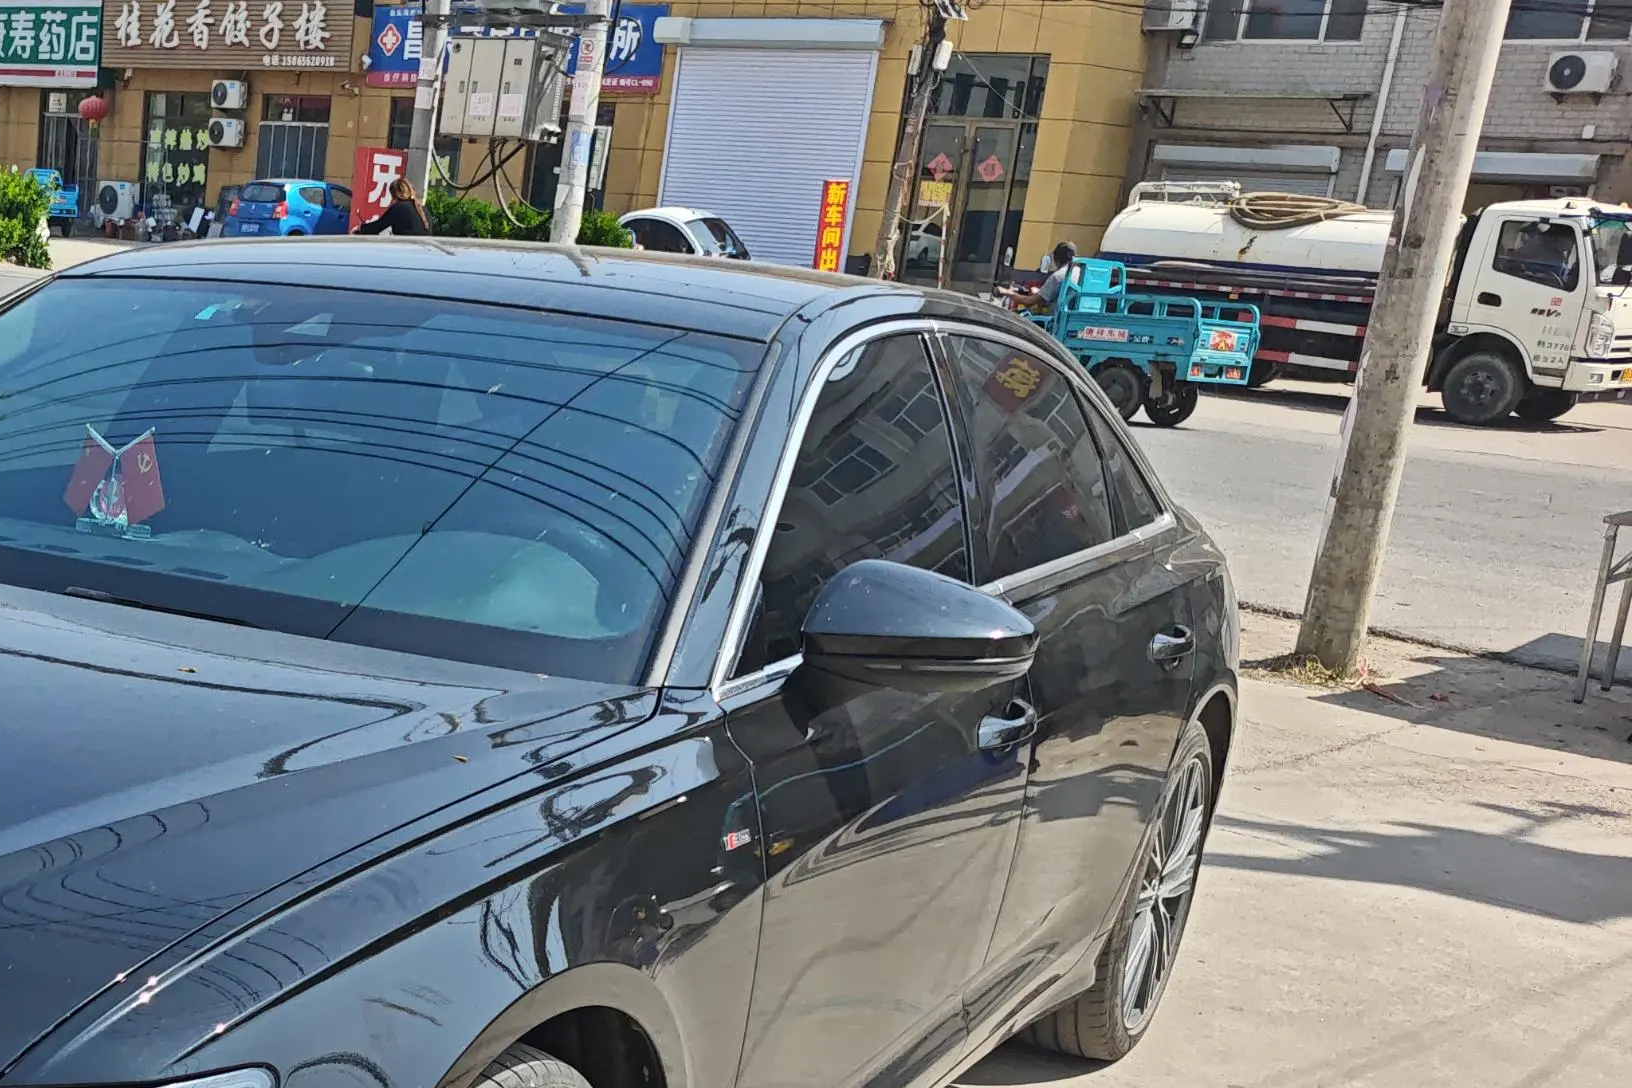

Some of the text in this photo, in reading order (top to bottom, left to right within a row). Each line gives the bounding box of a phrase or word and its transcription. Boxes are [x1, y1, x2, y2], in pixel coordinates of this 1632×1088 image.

[114, 0, 332, 50] 桂花香饺子楼
